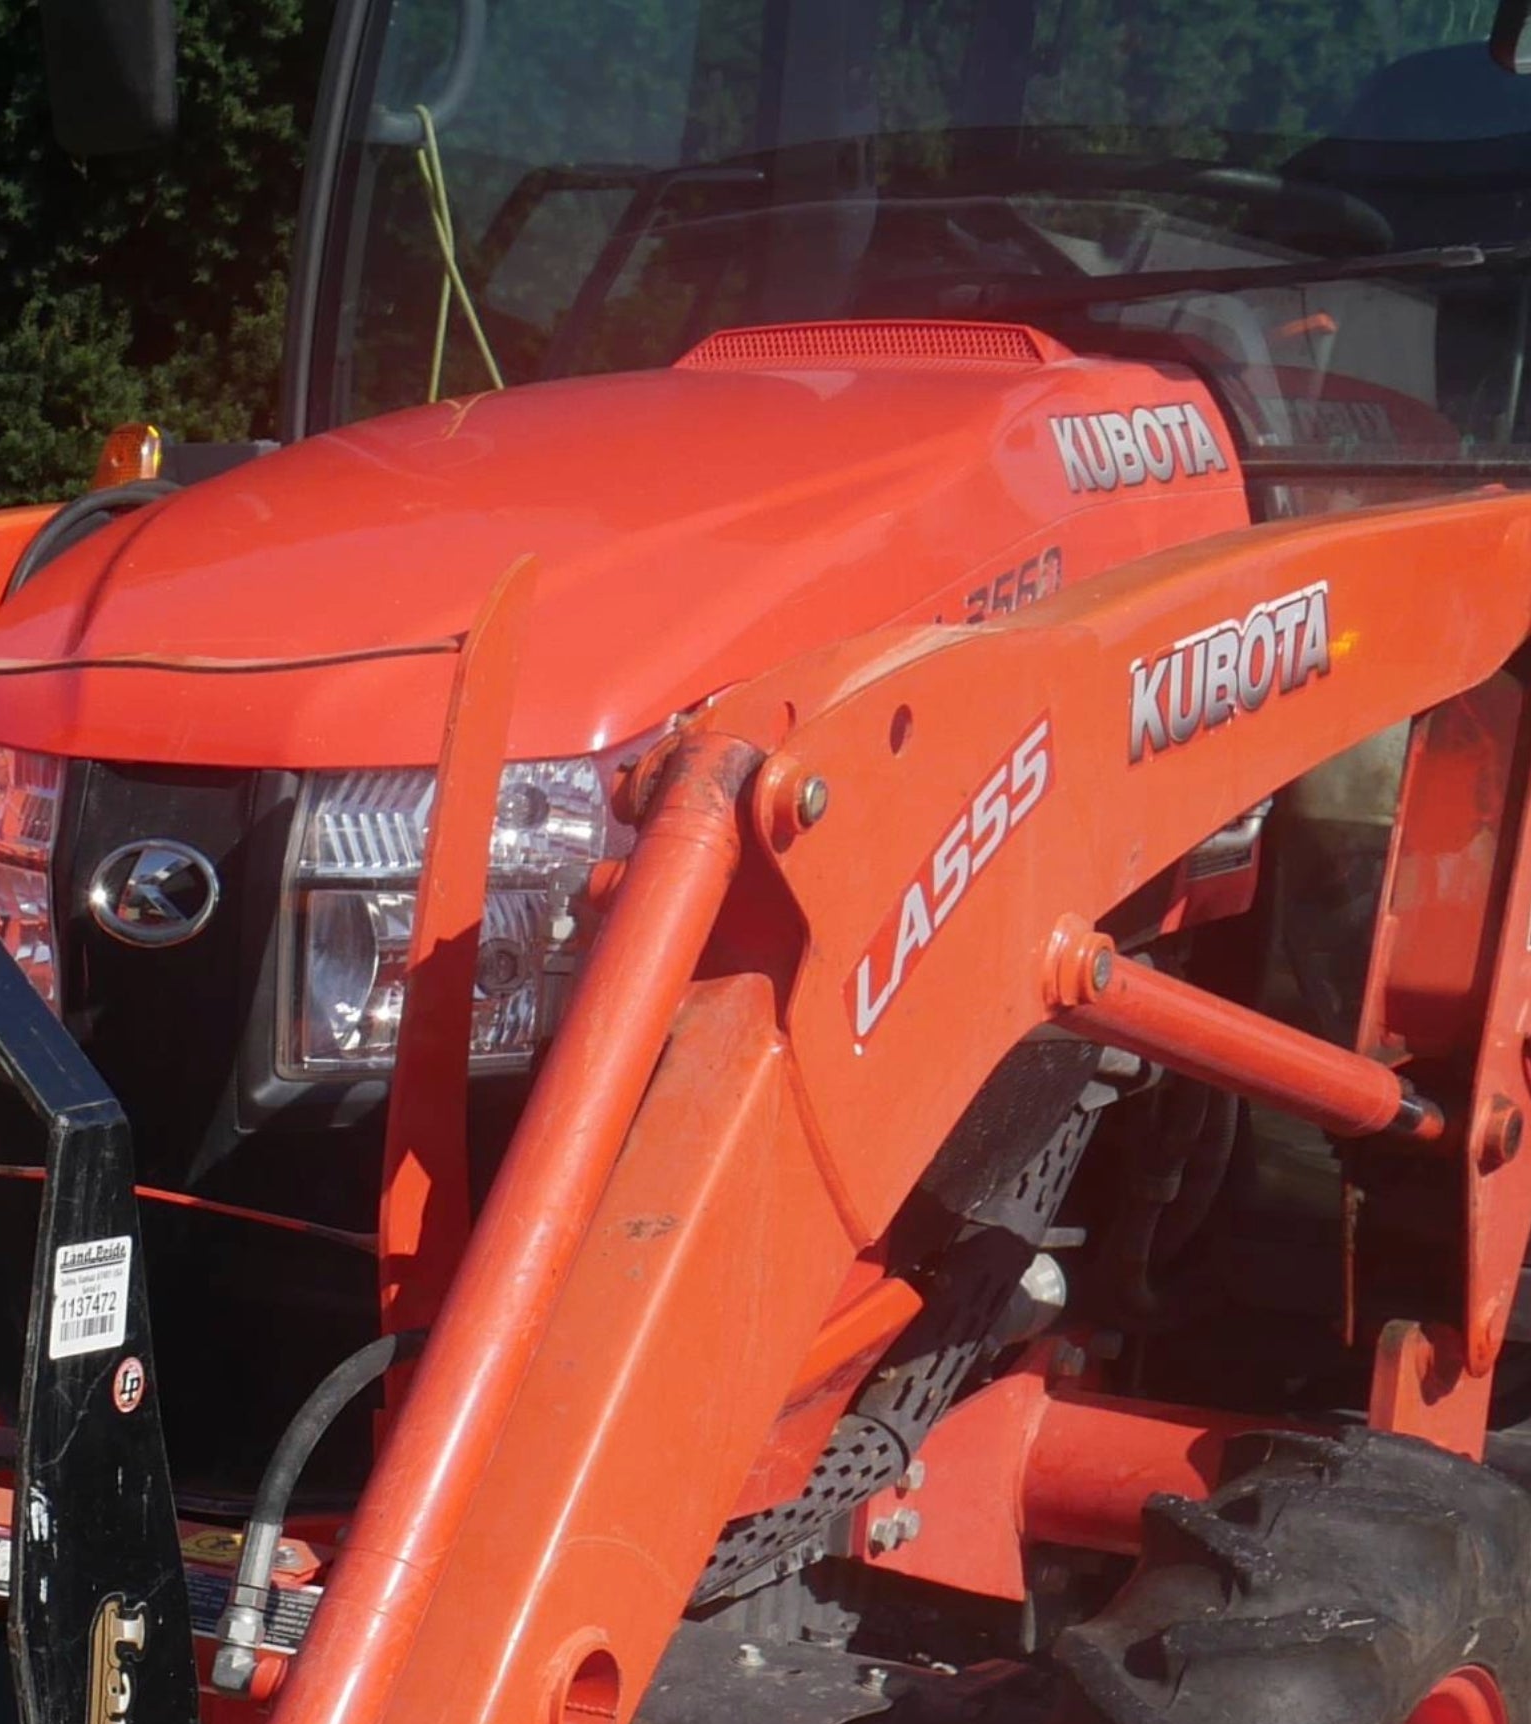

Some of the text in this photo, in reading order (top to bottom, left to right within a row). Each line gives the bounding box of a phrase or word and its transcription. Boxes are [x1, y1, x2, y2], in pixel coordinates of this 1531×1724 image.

[1049, 403, 1228, 492] KUBOTA
[1128, 588, 1331, 766] KUBOTA
[851, 719, 1050, 1040] LA555
[60, 1291, 118, 1321] 1137472
